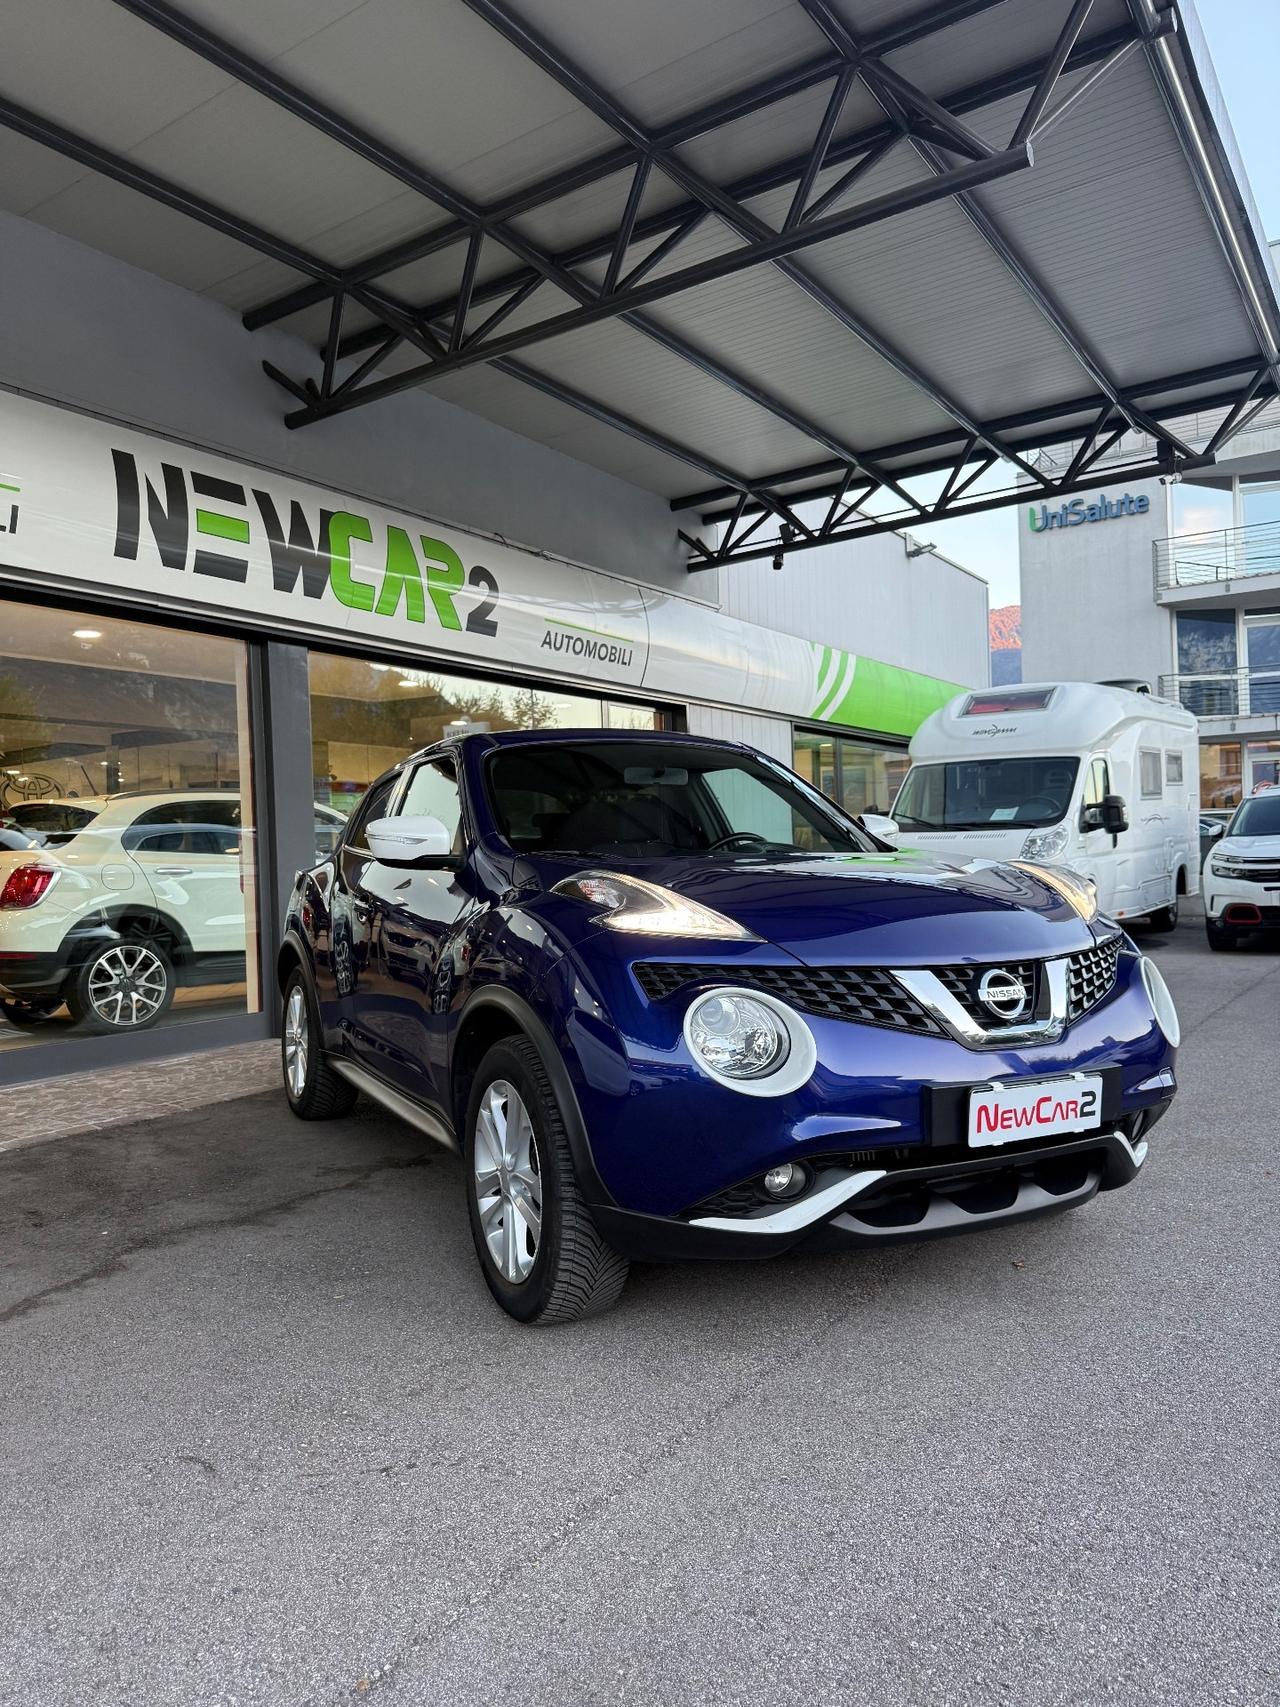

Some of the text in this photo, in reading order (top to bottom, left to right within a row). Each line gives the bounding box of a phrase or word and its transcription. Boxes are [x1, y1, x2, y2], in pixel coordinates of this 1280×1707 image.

[1029, 493, 1150, 532] UniSalute
[541, 630, 633, 666] AUTOMOBILI
[986, 988, 1025, 999] NISSAN
